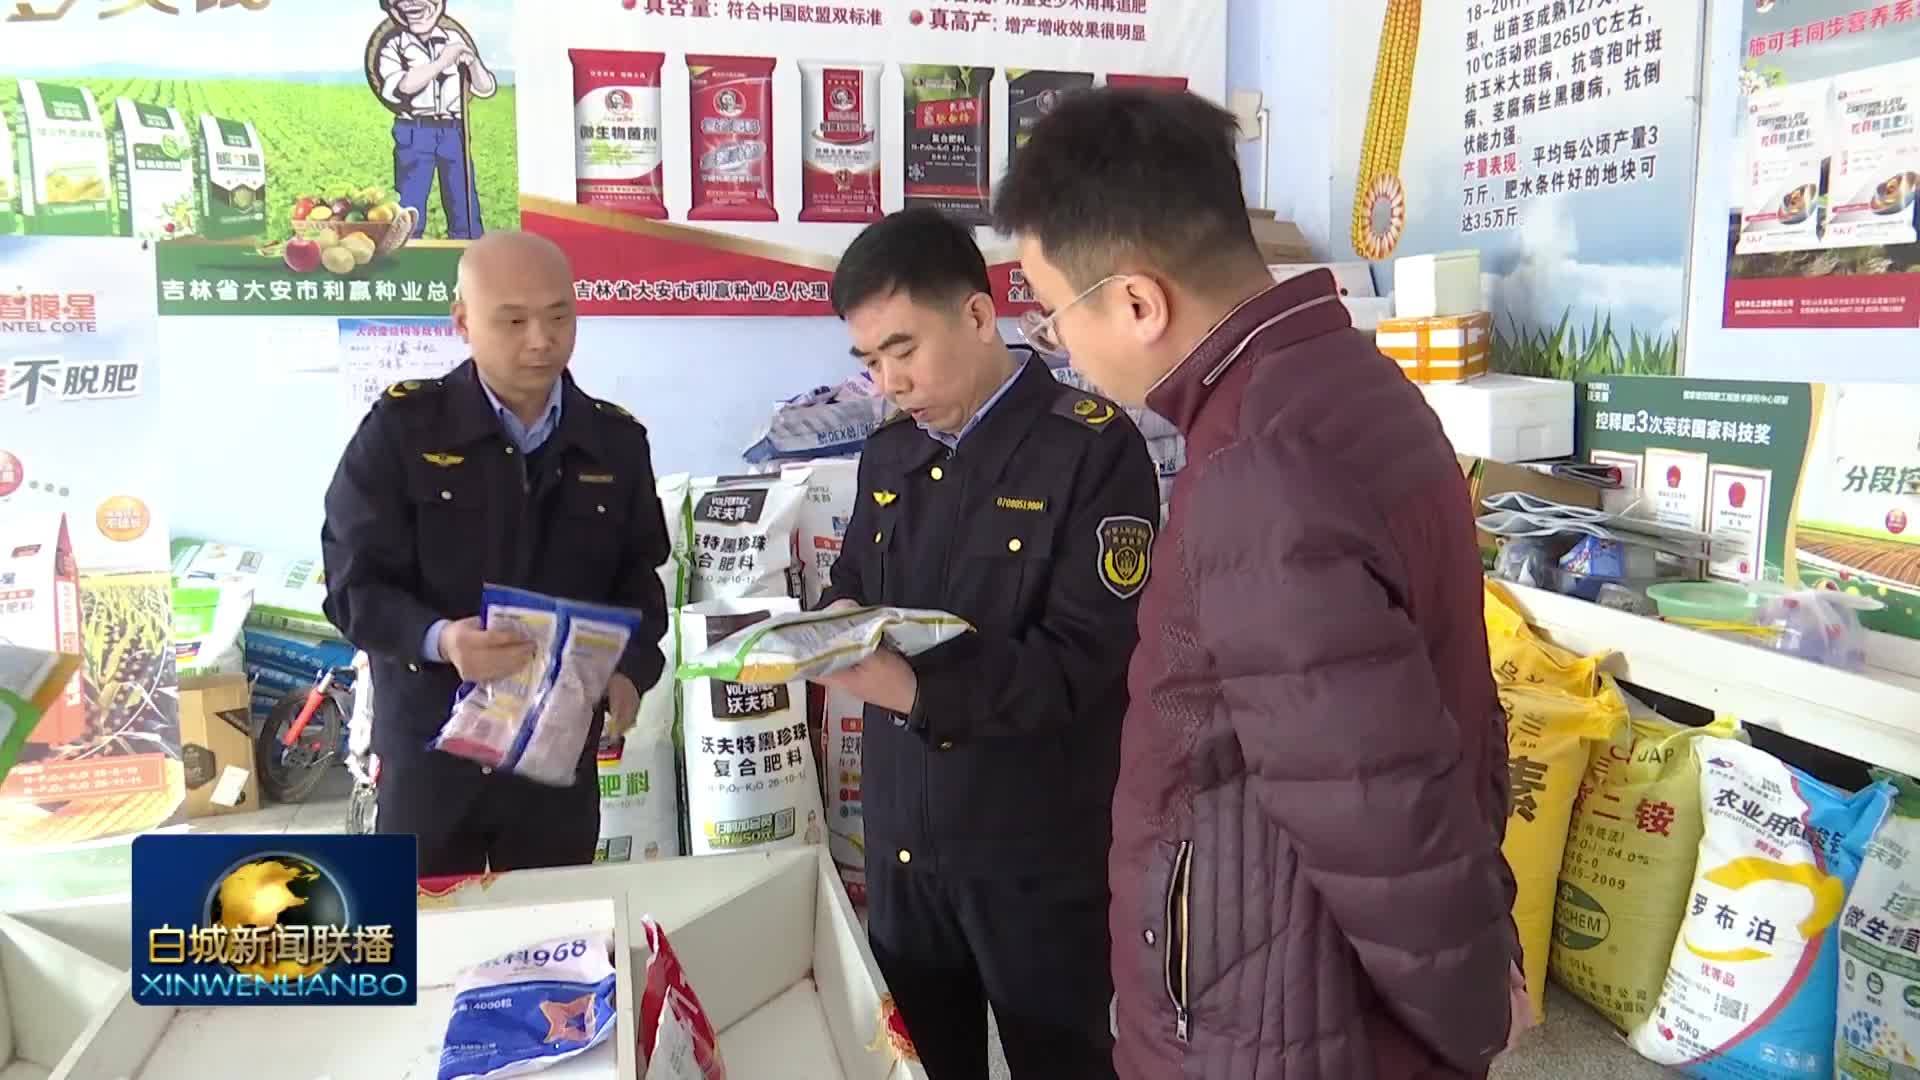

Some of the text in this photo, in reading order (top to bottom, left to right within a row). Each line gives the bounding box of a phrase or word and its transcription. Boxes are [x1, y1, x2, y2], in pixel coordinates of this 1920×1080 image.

[1749, 0, 1920, 57] 施可丰同步营养系
[1595, 410, 1771, 445] 控释肥3次荣获国家科技奖
[694, 553, 754, 572] 合肥料
[727, 692, 775, 713] 沃夫特
[701, 722, 808, 755] 沃夫特黑珍珠
[713, 749, 802, 777] 复合肥料
